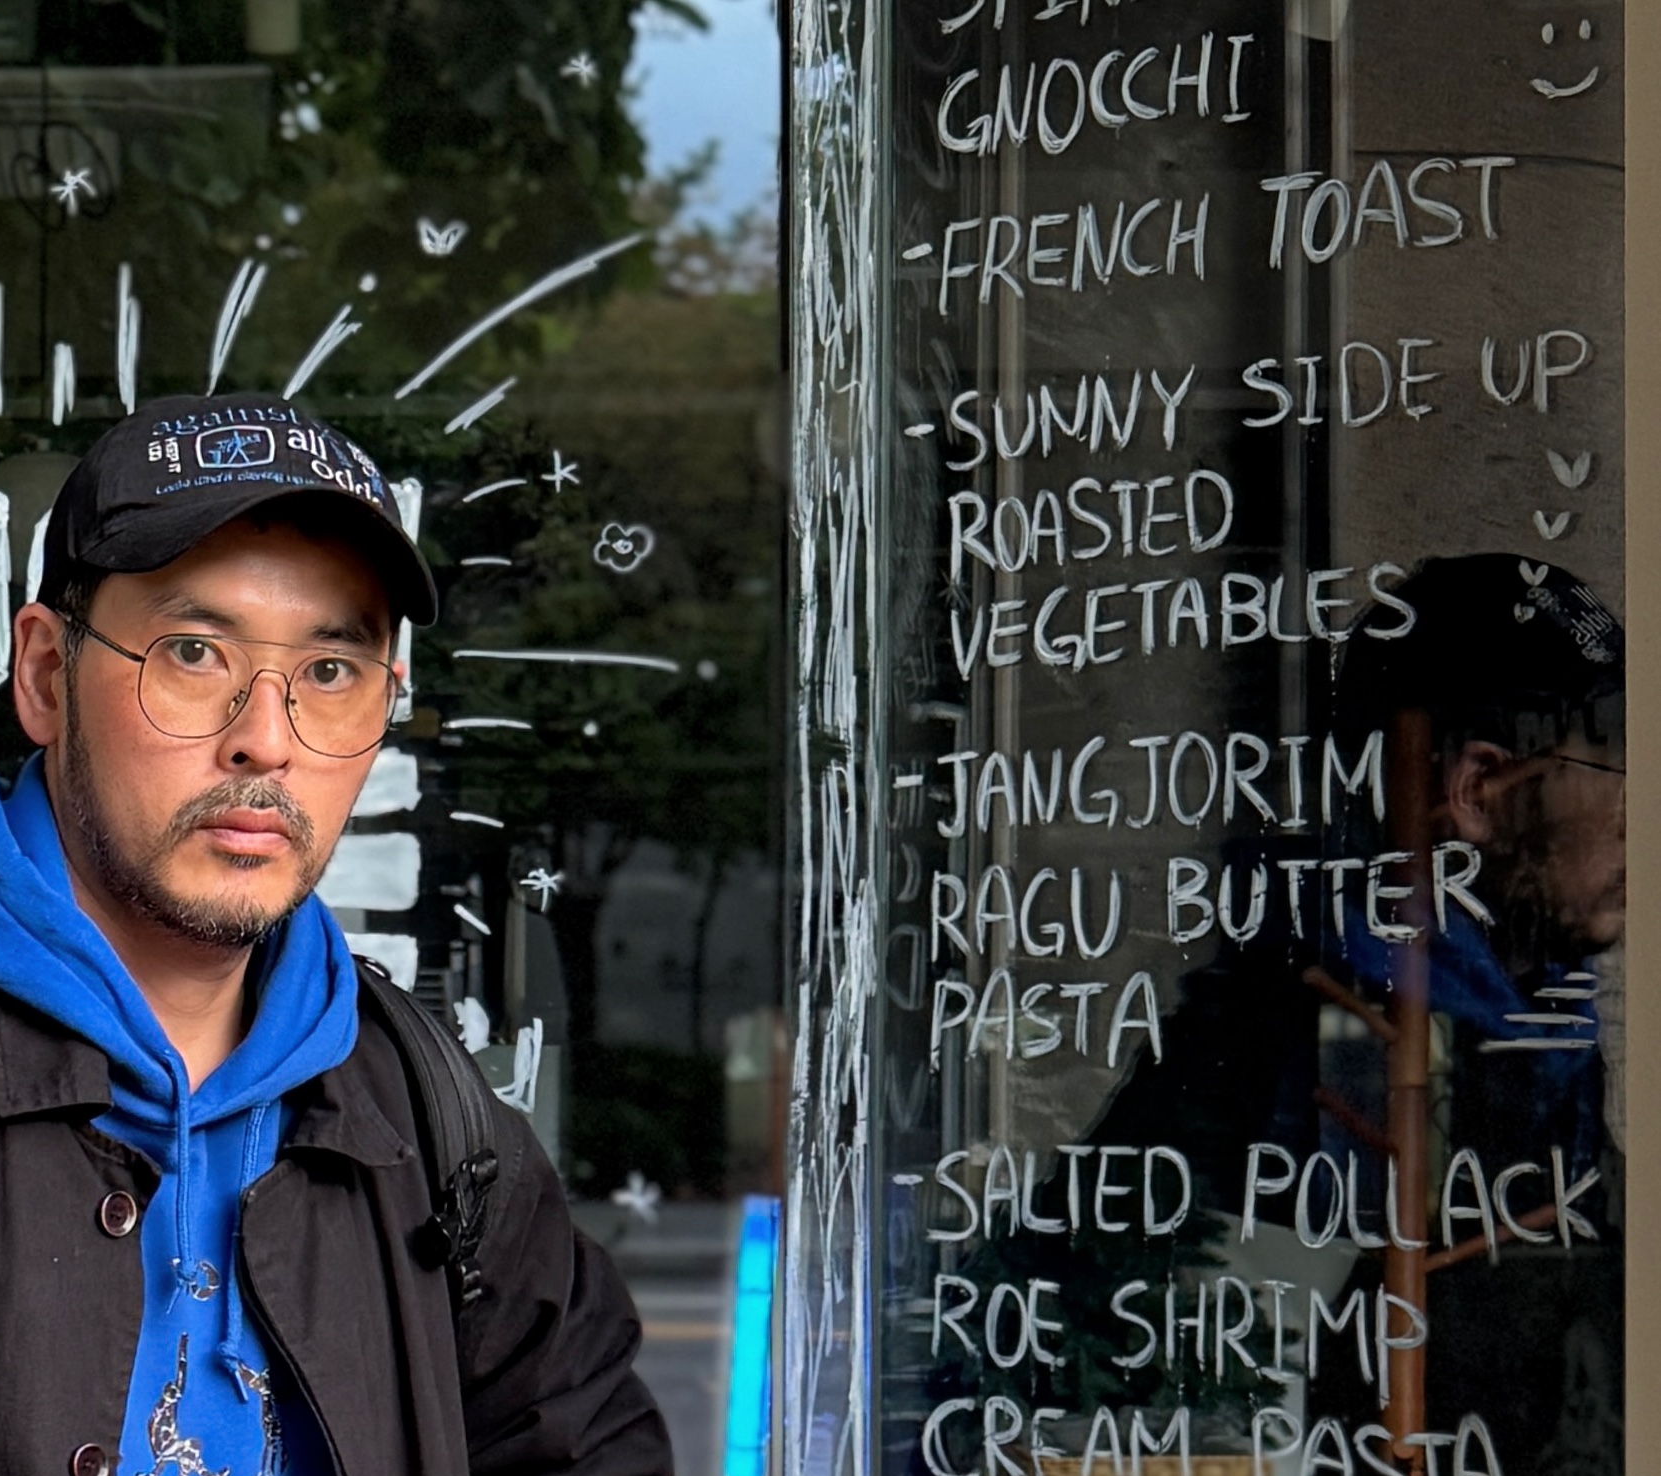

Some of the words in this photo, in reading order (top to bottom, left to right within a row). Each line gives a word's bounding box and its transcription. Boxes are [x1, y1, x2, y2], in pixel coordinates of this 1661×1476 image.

[937, 32, 1254, 157] GNOCCHI
[1260, 157, 1516, 269] TOAST
[151, 405, 301, 436] against
[1241, 339, 1440, 428] SIDE
[1481, 330, 1589, 412] UP
[287, 428, 327, 461] all
[950, 470, 1235, 585] ROASTED
[951, 562, 1417, 681] VEGETABLES
[931, 865, 1121, 963] RAGU
[1167, 840, 1495, 946] BUTTER
[929, 971, 1163, 1074] PASTA
[1239, 1142, 1601, 1264] POLLACK
[931, 1275, 1065, 1368] ROE
[1110, 1275, 1429, 1410] SHRIMP
